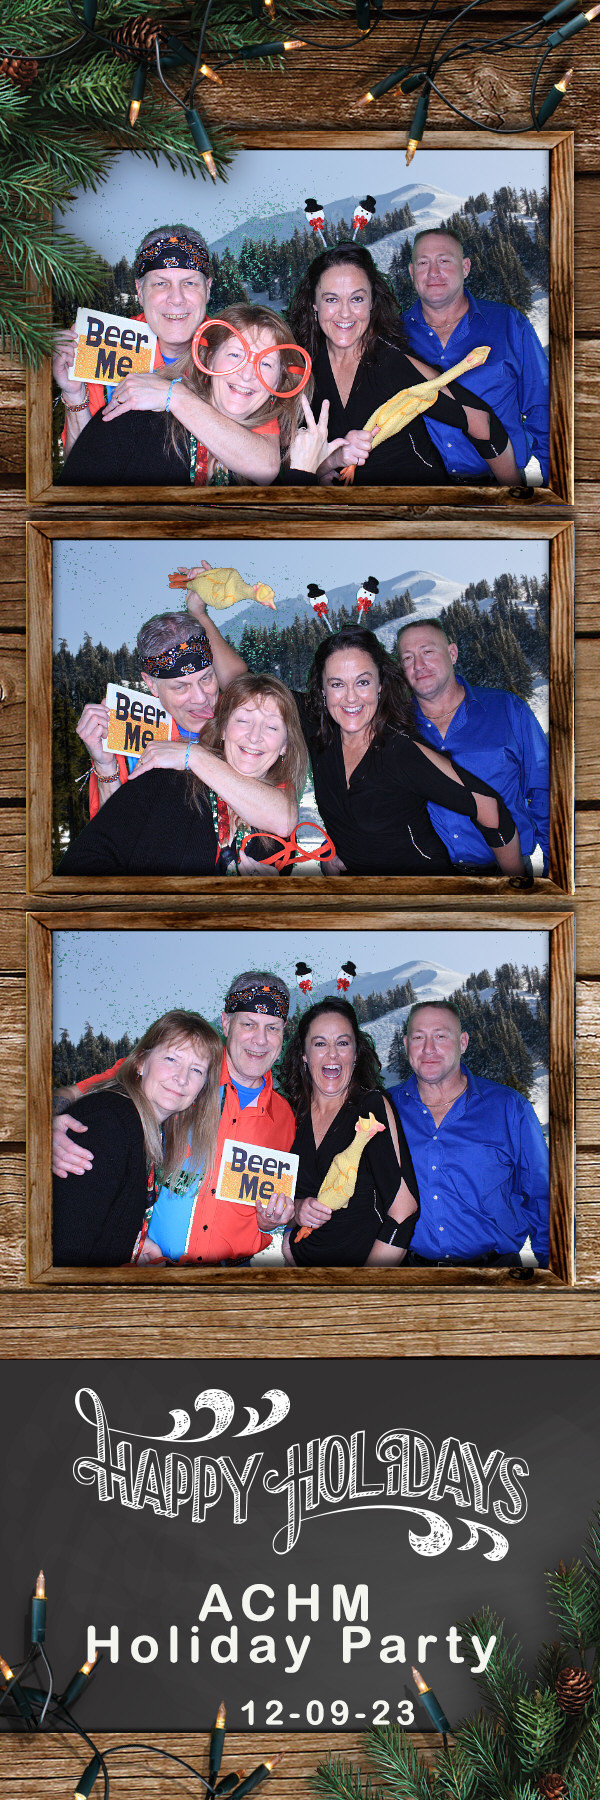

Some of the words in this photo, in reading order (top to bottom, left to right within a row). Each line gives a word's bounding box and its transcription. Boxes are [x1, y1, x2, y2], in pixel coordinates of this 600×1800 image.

[86, 316, 149, 354] Beer
[95, 348, 133, 380] Me
[116, 692, 167, 729] Beer
[231, 1146, 291, 1180] Beer
[239, 1173, 275, 1201] Me
